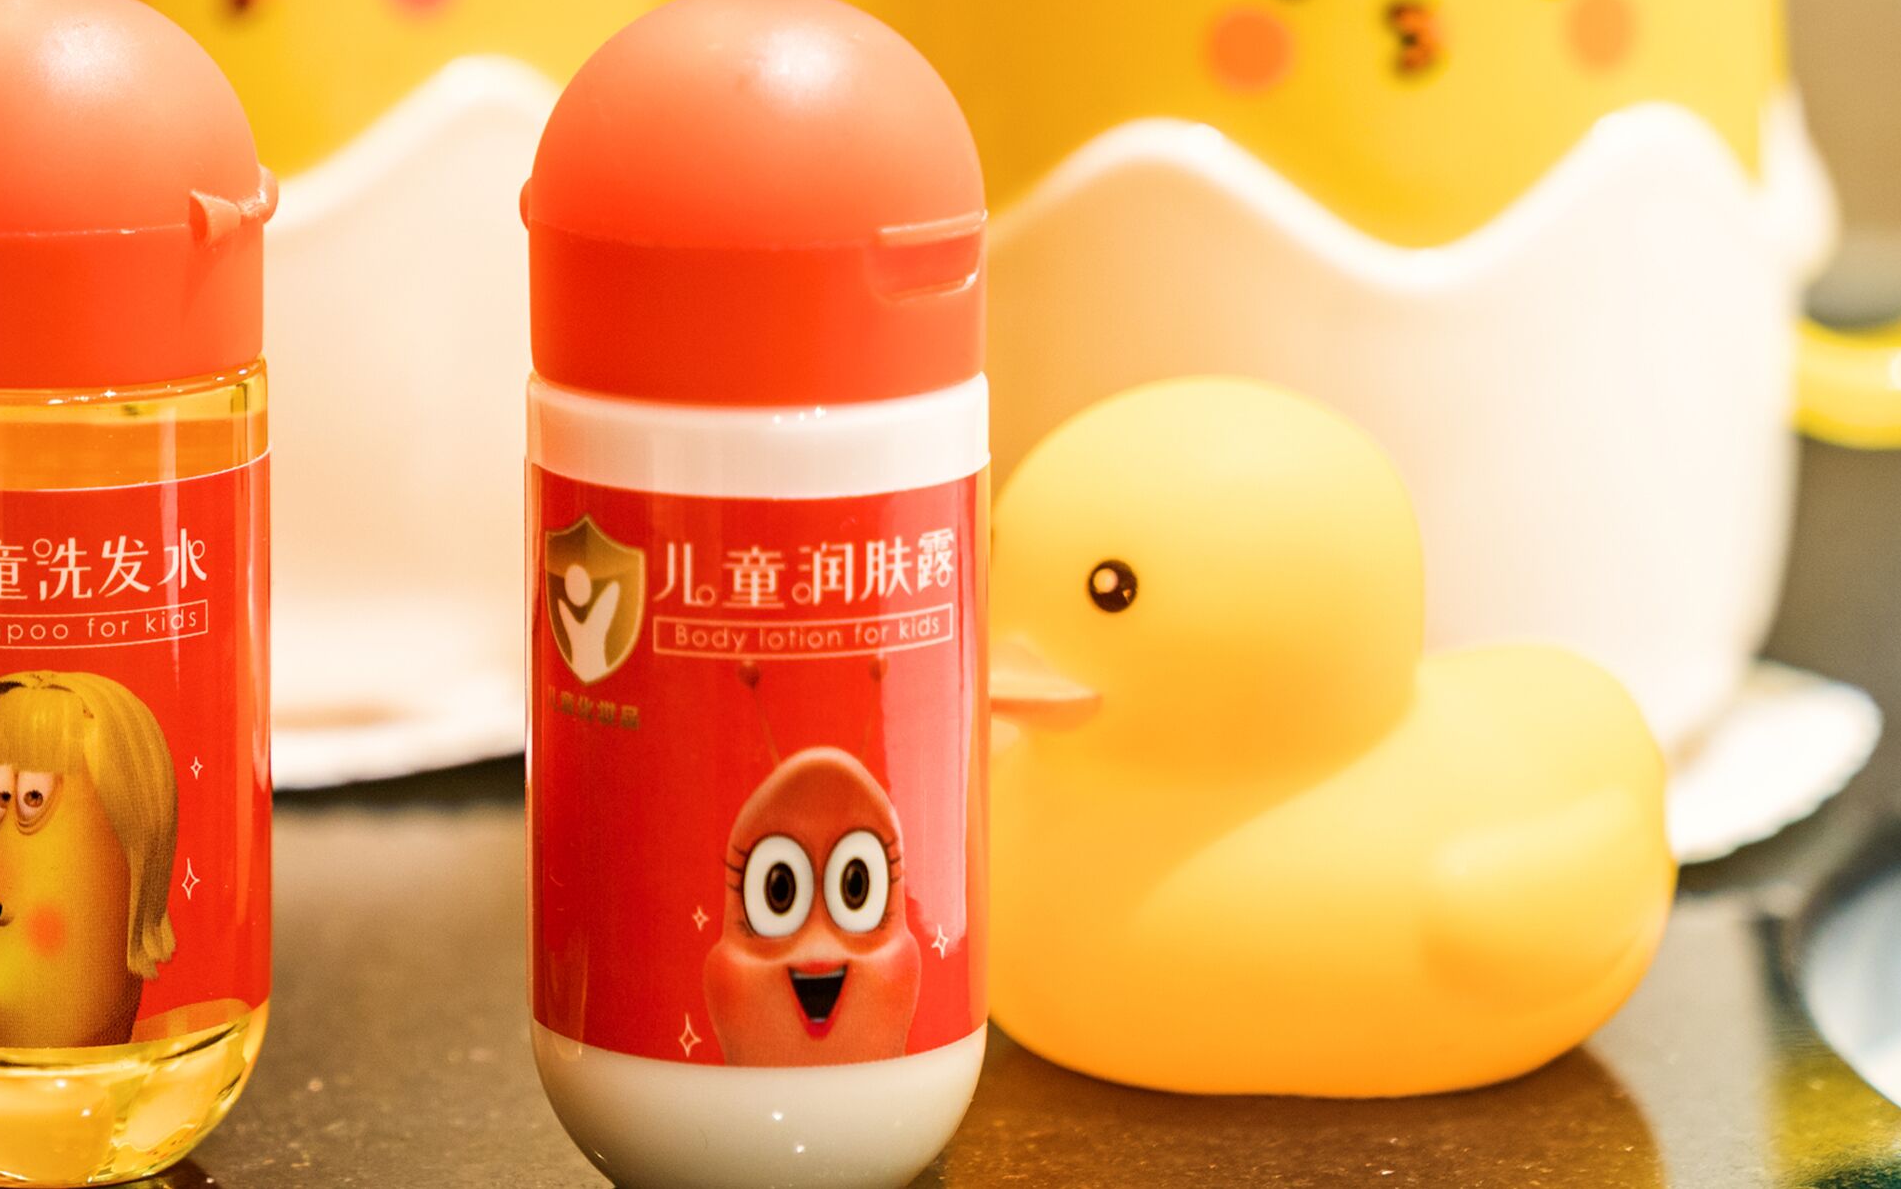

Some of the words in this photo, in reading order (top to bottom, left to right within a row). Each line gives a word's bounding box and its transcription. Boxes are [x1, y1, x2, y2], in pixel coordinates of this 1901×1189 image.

[653, 527, 955, 608] 儿童润肤露
[87, 617, 131, 638] for
[145, 610, 198, 634] kids
[674, 624, 747, 652] Body
[759, 627, 843, 650] lotion
[854, 622, 890, 644] for
[899, 614, 941, 640] kids
